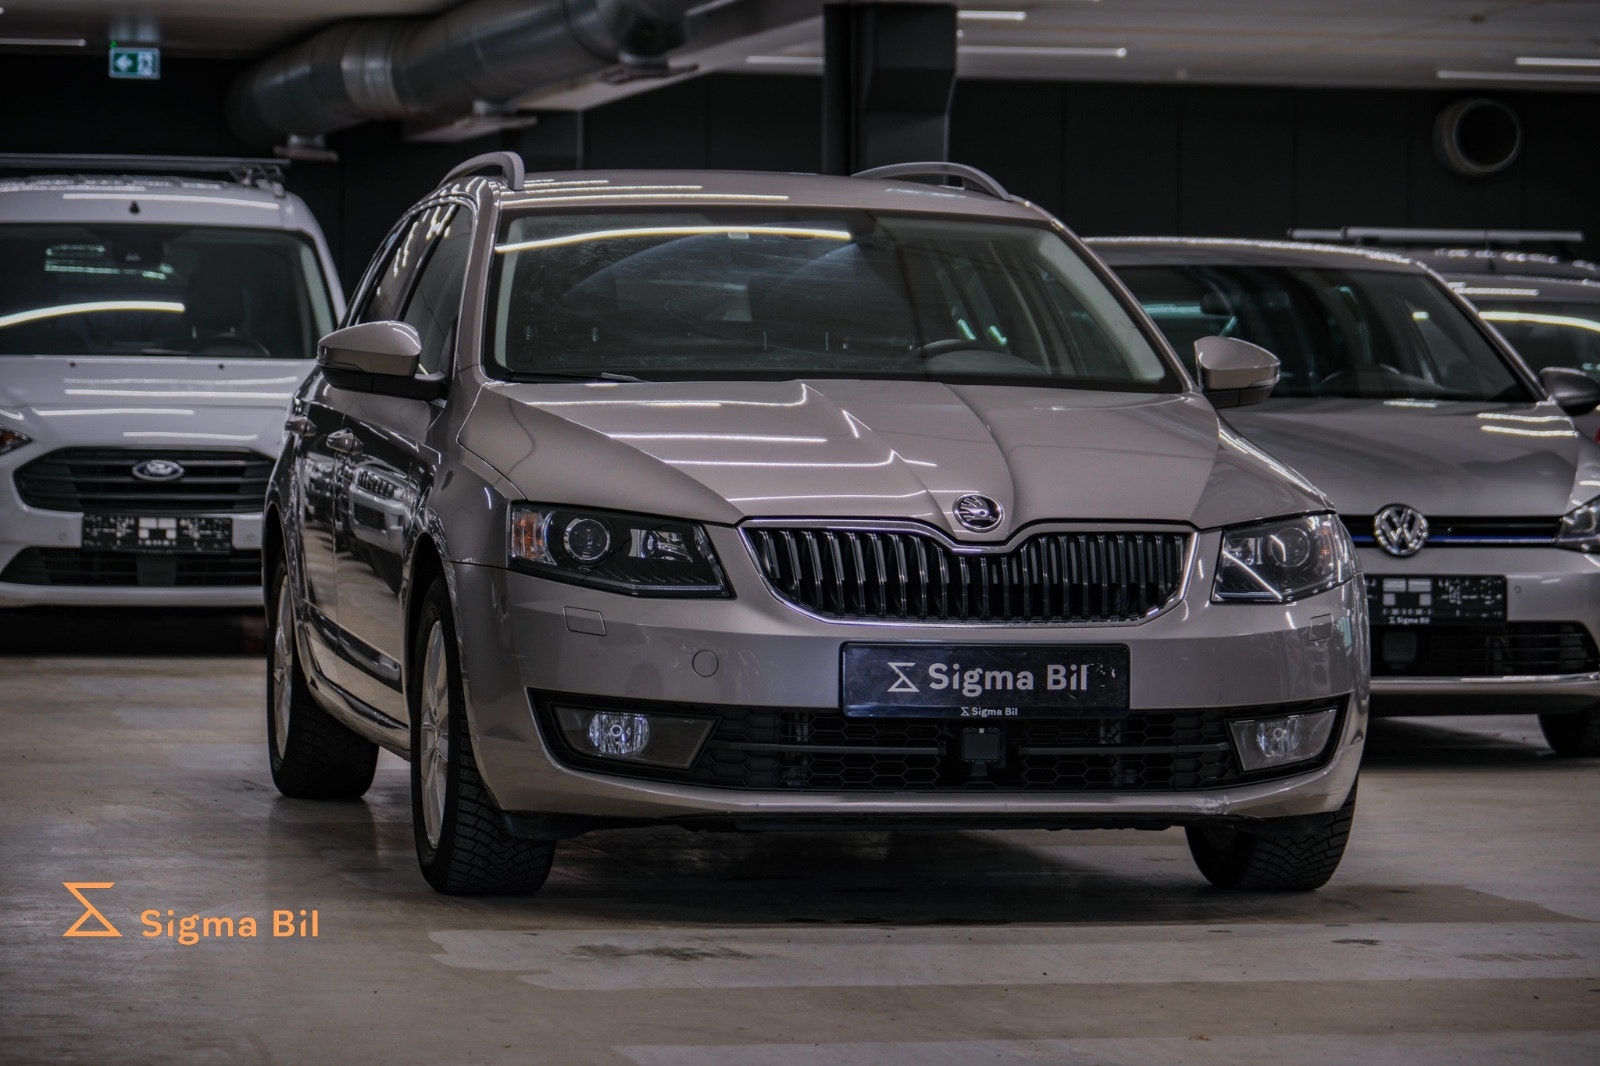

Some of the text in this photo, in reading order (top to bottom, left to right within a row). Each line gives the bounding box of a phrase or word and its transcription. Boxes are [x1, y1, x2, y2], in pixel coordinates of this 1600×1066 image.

[928, 662, 1088, 697] Sigma Bil
[971, 706, 1018, 718] Sigma Bil
